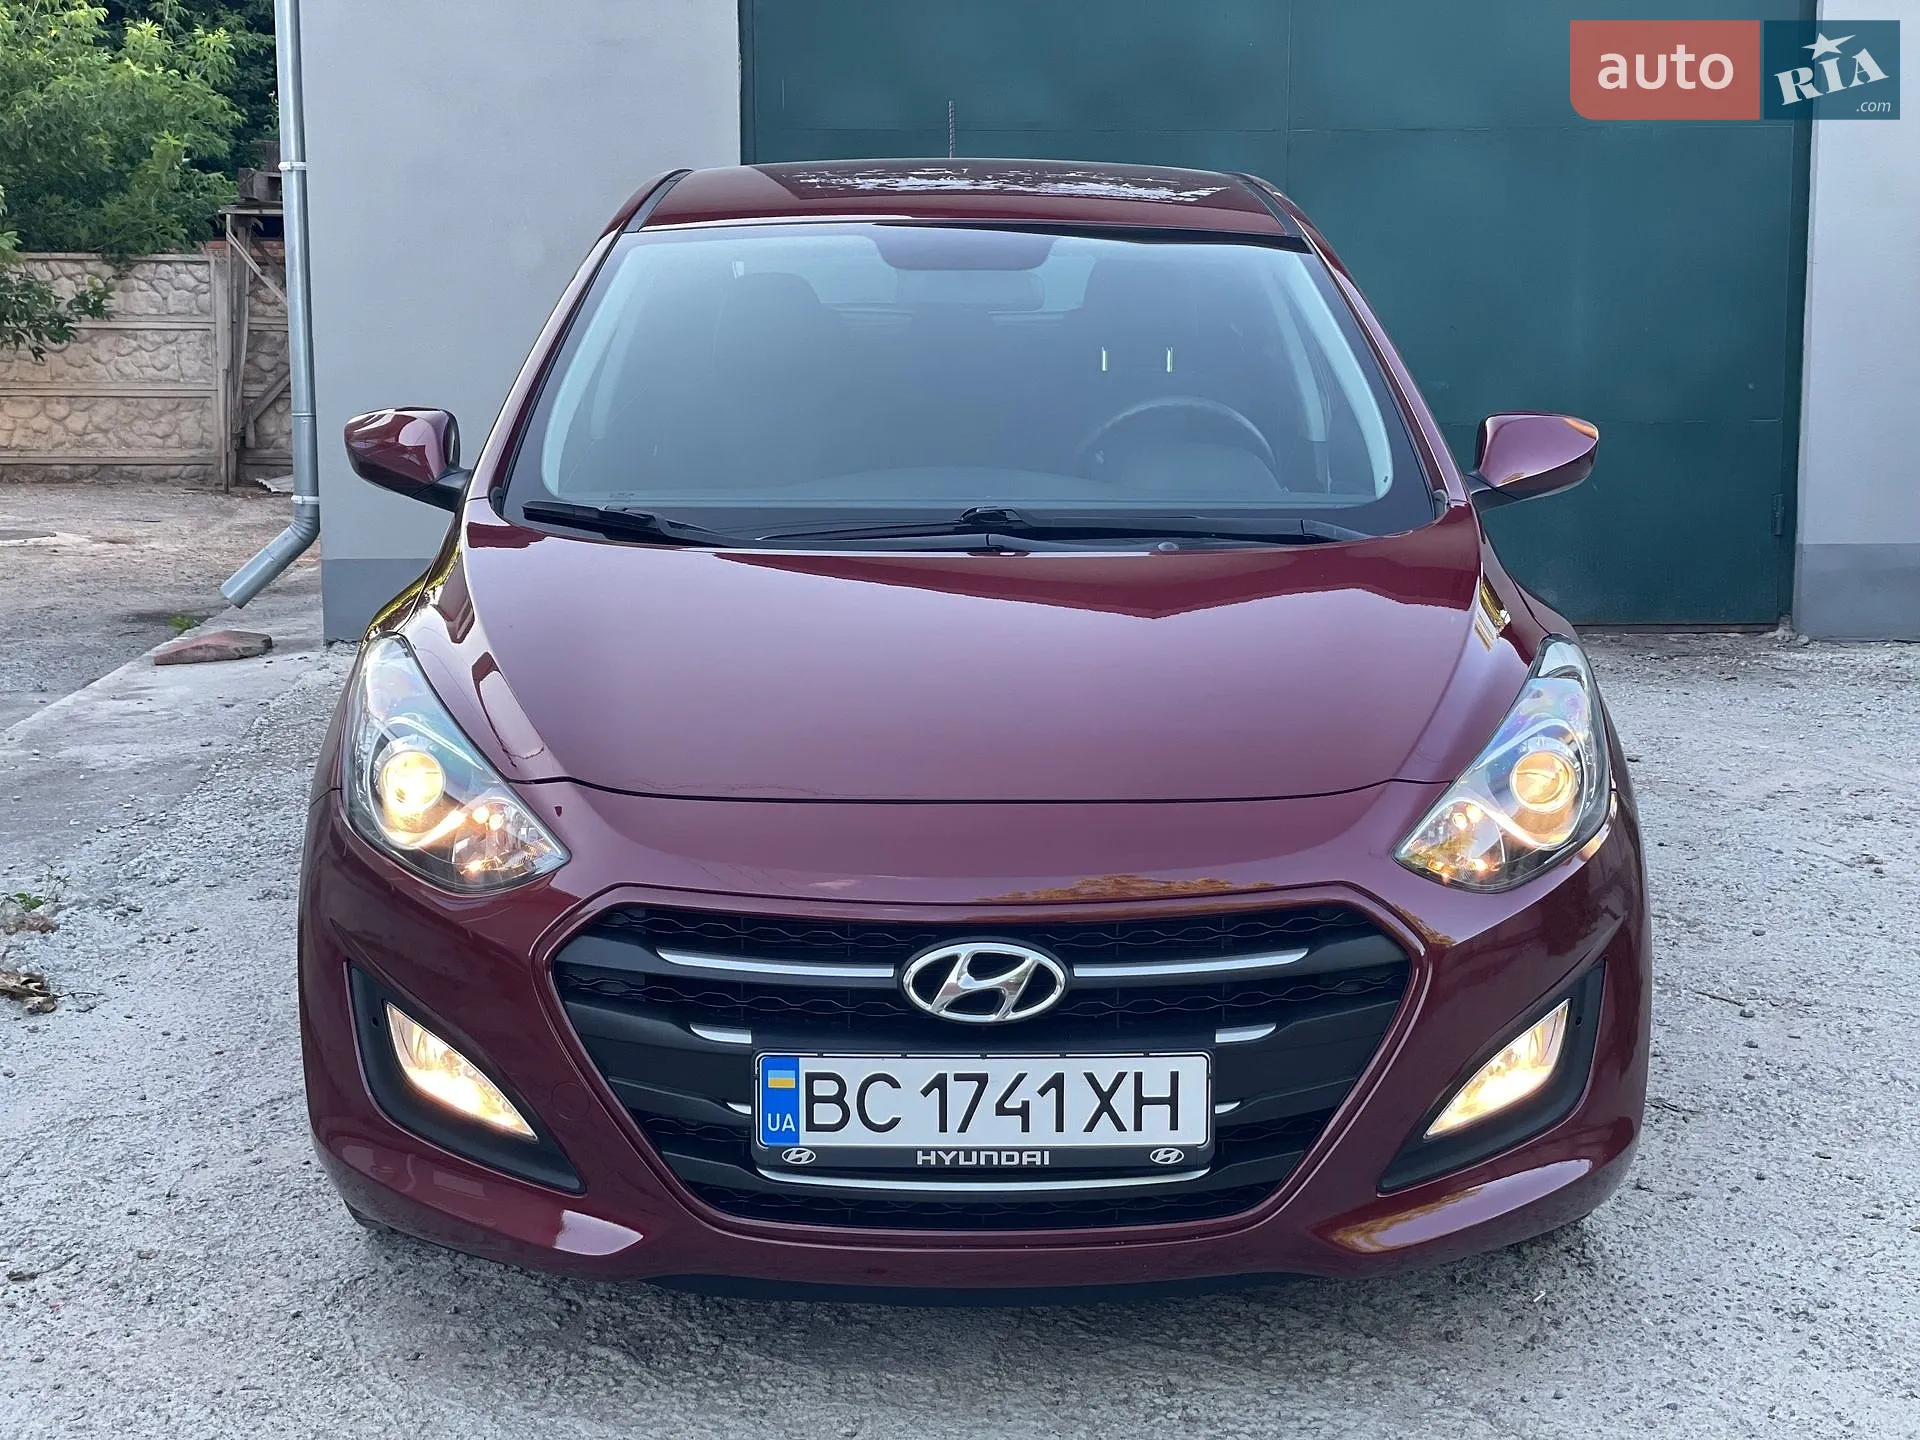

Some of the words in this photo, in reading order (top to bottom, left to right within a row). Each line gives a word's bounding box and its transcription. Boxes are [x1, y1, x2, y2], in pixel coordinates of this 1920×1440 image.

[804, 1071, 902, 1134] BC
[919, 1072, 1065, 1134] 1741
[1082, 1070, 1180, 1133] XH
[767, 1112, 796, 1132] UA
[916, 1150, 1050, 1166] HYUNDAI
